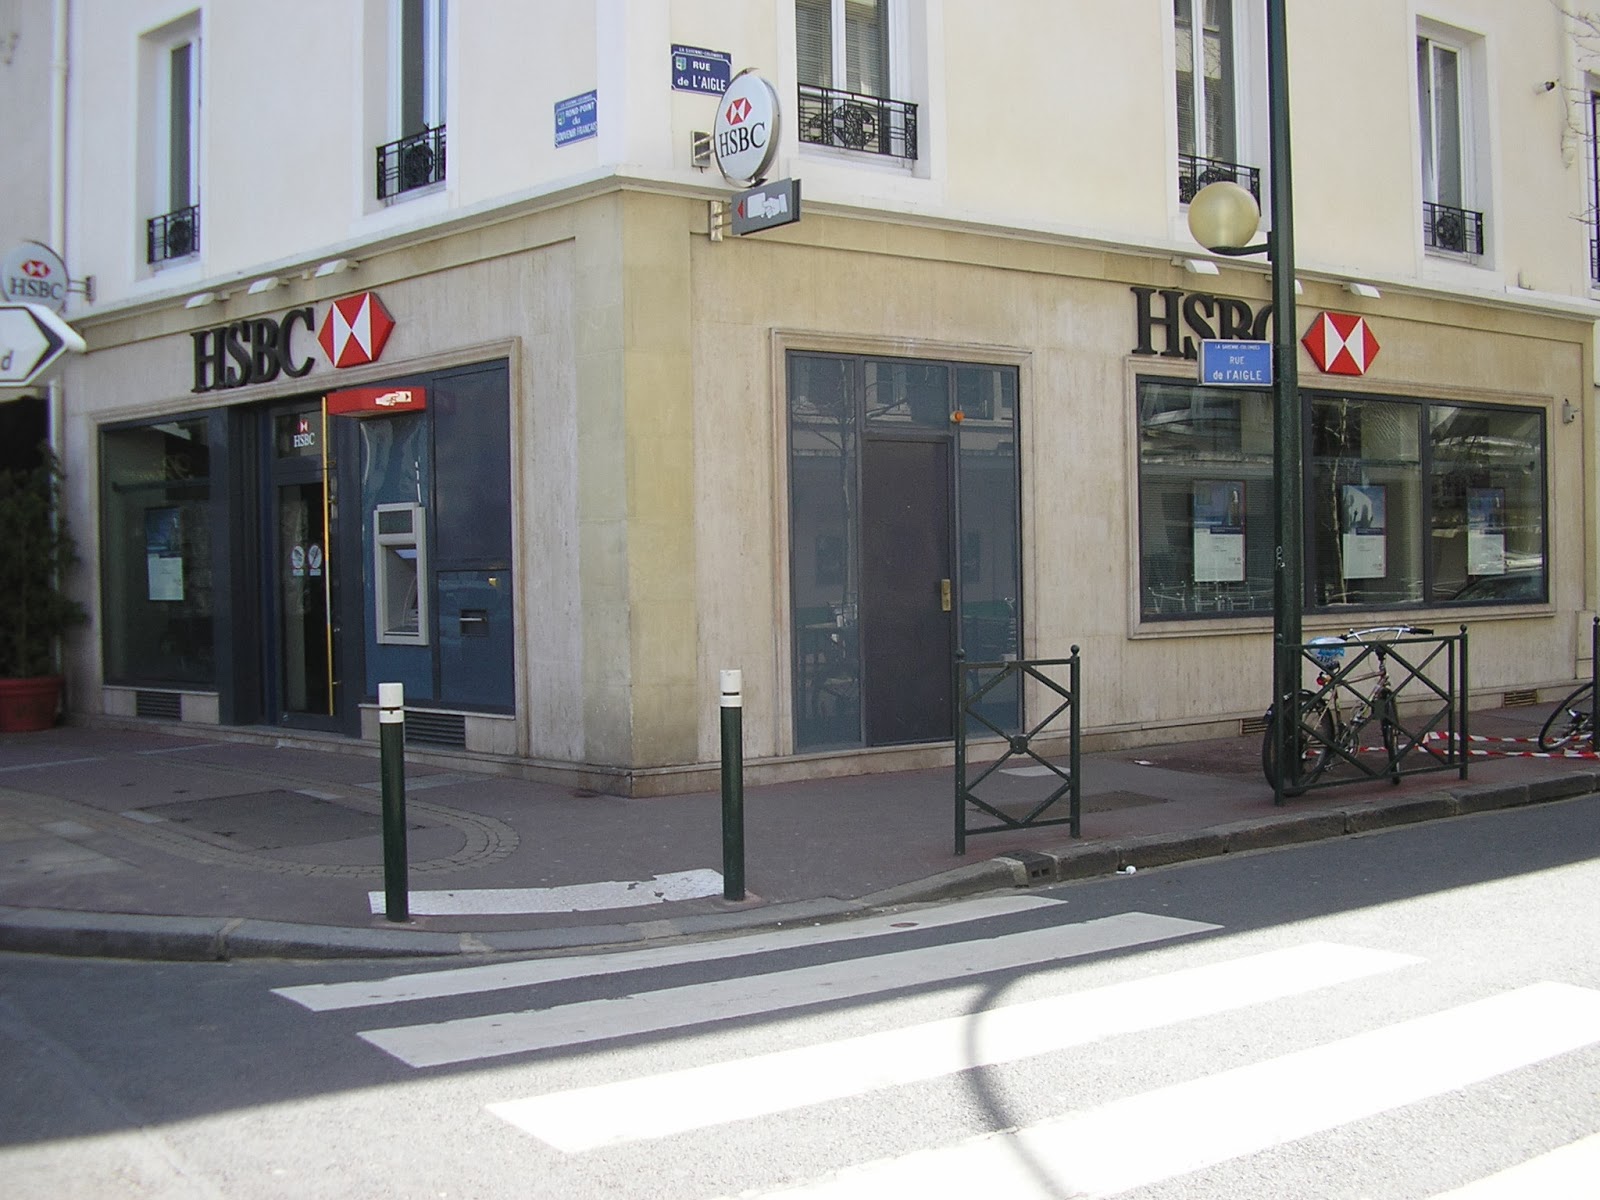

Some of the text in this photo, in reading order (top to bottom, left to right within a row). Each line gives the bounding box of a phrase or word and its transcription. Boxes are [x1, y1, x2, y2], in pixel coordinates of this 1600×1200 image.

[692, 61, 711, 72] RUE
[677, 75, 726, 92] de L'AIGLE
[572, 115, 581, 126] du
[719, 121, 766, 159] HSBC
[10, 278, 63, 301] HSBC
[189, 307, 316, 394] HSBC
[1229, 356, 1245, 365] RUE
[1212, 370, 1224, 380] de
[293, 432, 315, 448] HSBC
